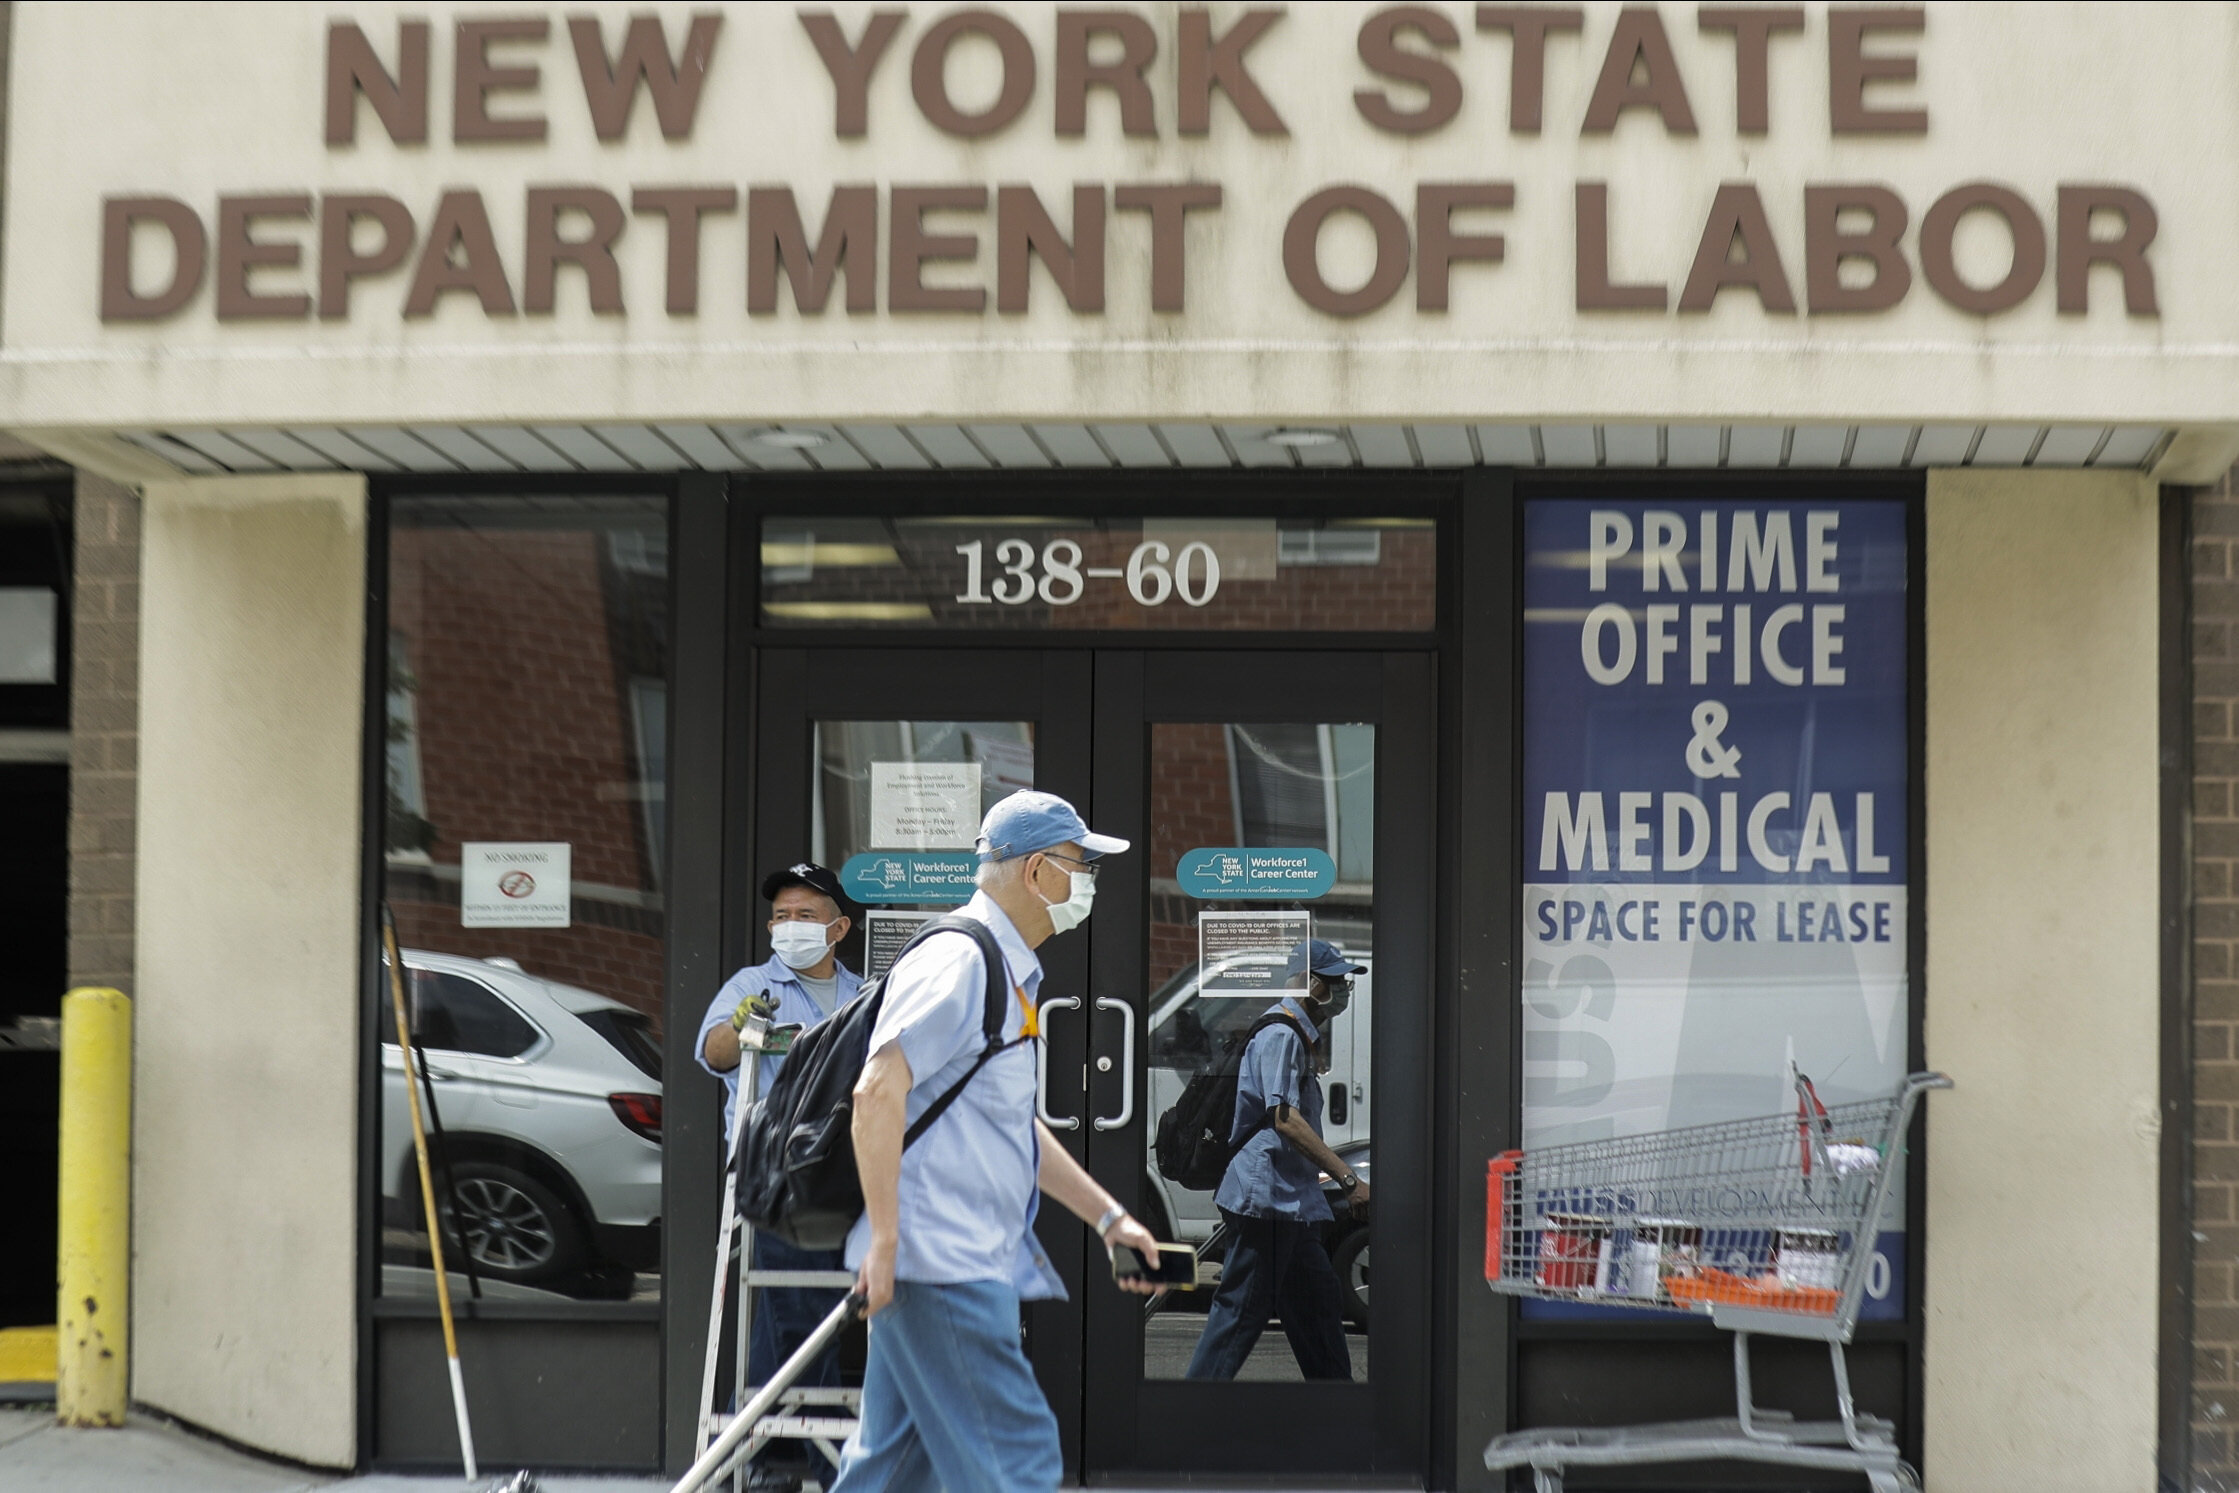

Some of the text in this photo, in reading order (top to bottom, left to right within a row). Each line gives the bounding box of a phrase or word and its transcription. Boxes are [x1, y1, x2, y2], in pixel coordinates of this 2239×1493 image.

[324, 6, 1928, 149] NEW YORK STATE
[100, 180, 2162, 324] DEPARTMENT OF LABOR
[1589, 509, 1840, 593] PRIME
[1581, 602, 1846, 687] OFFICE
[1685, 699, 1742, 779] &
[896, 817, 926, 826] Monday
[933, 817, 956, 826] Friday
[1539, 791, 1890, 874] MEDICAL
[913, 862, 970, 873] Workforce1
[913, 874, 977, 884] Career Cente
[1250, 869, 1318, 879] Career Center
[1251, 857, 1307, 867] Workforce1
[1537, 899, 1891, 943] SPACE FOR LEASE
[1638, 1188, 1843, 1218] DEVELOPMENT
